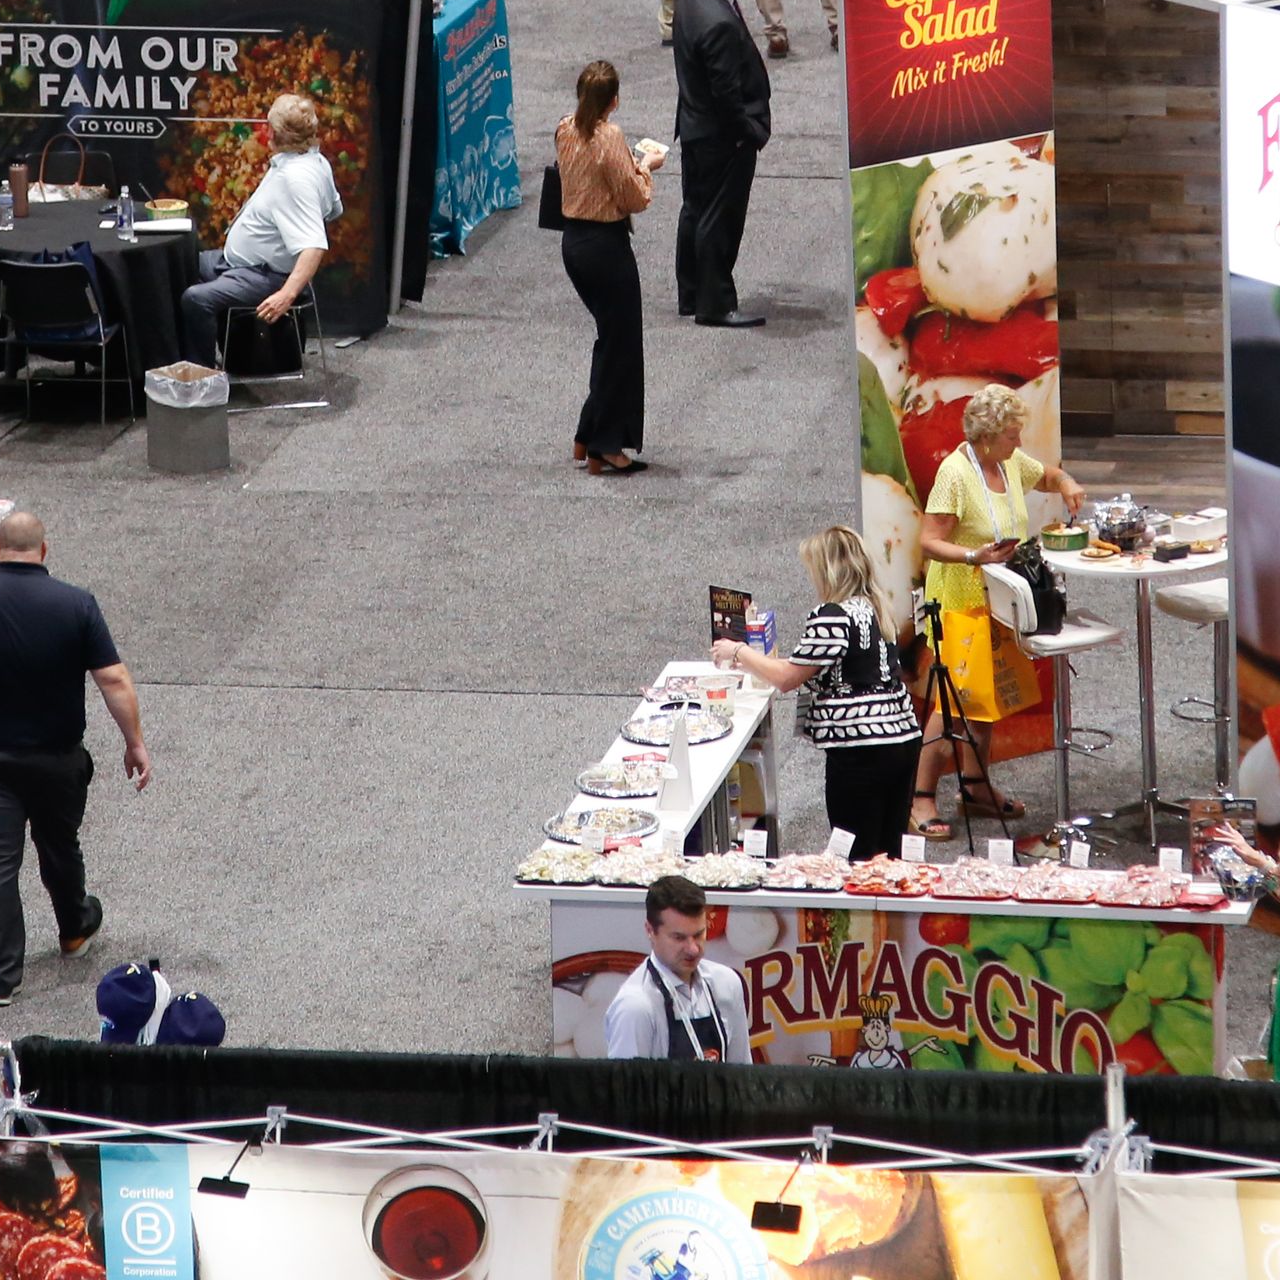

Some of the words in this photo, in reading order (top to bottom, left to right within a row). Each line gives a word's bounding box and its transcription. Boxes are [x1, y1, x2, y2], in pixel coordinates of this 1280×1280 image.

[141, 37, 238, 73] OUR
[891, 67, 928, 98] Mix
[930, 63, 947, 90] it
[951, 37, 1010, 81] Fresh!
[38, 72, 198, 111] FAMILY
[80, 120, 99, 133] TO
[102, 120, 155, 134] YOURS
[119, 1186, 174, 1200] Certified
[135, 1212, 162, 1245] B
[122, 1266, 177, 1277] Corporation
